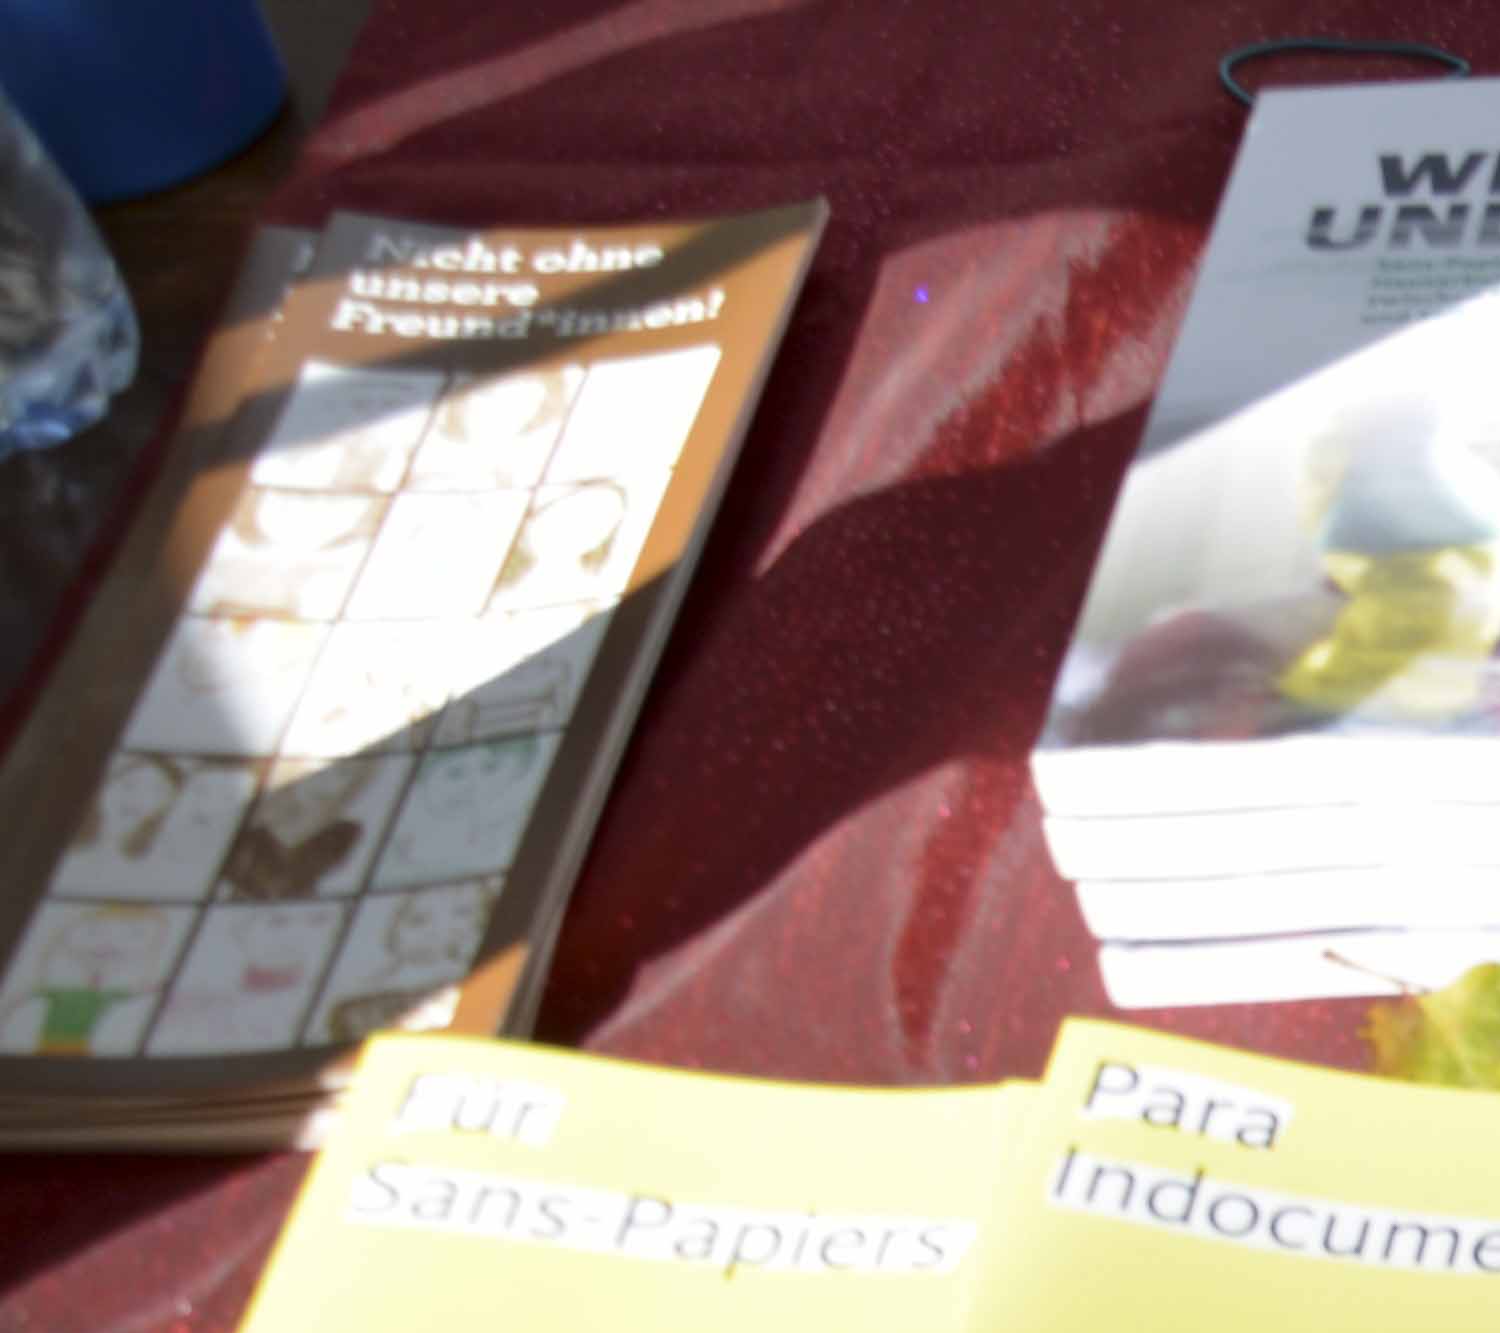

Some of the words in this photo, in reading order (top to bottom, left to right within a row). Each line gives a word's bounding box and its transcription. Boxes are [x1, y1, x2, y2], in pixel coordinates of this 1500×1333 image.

[532, 237, 665, 275] ohne
[349, 271, 540, 307] unsere
[1083, 1060, 1284, 1152] Para
[354, 1157, 948, 1282] Sans-Papiers
